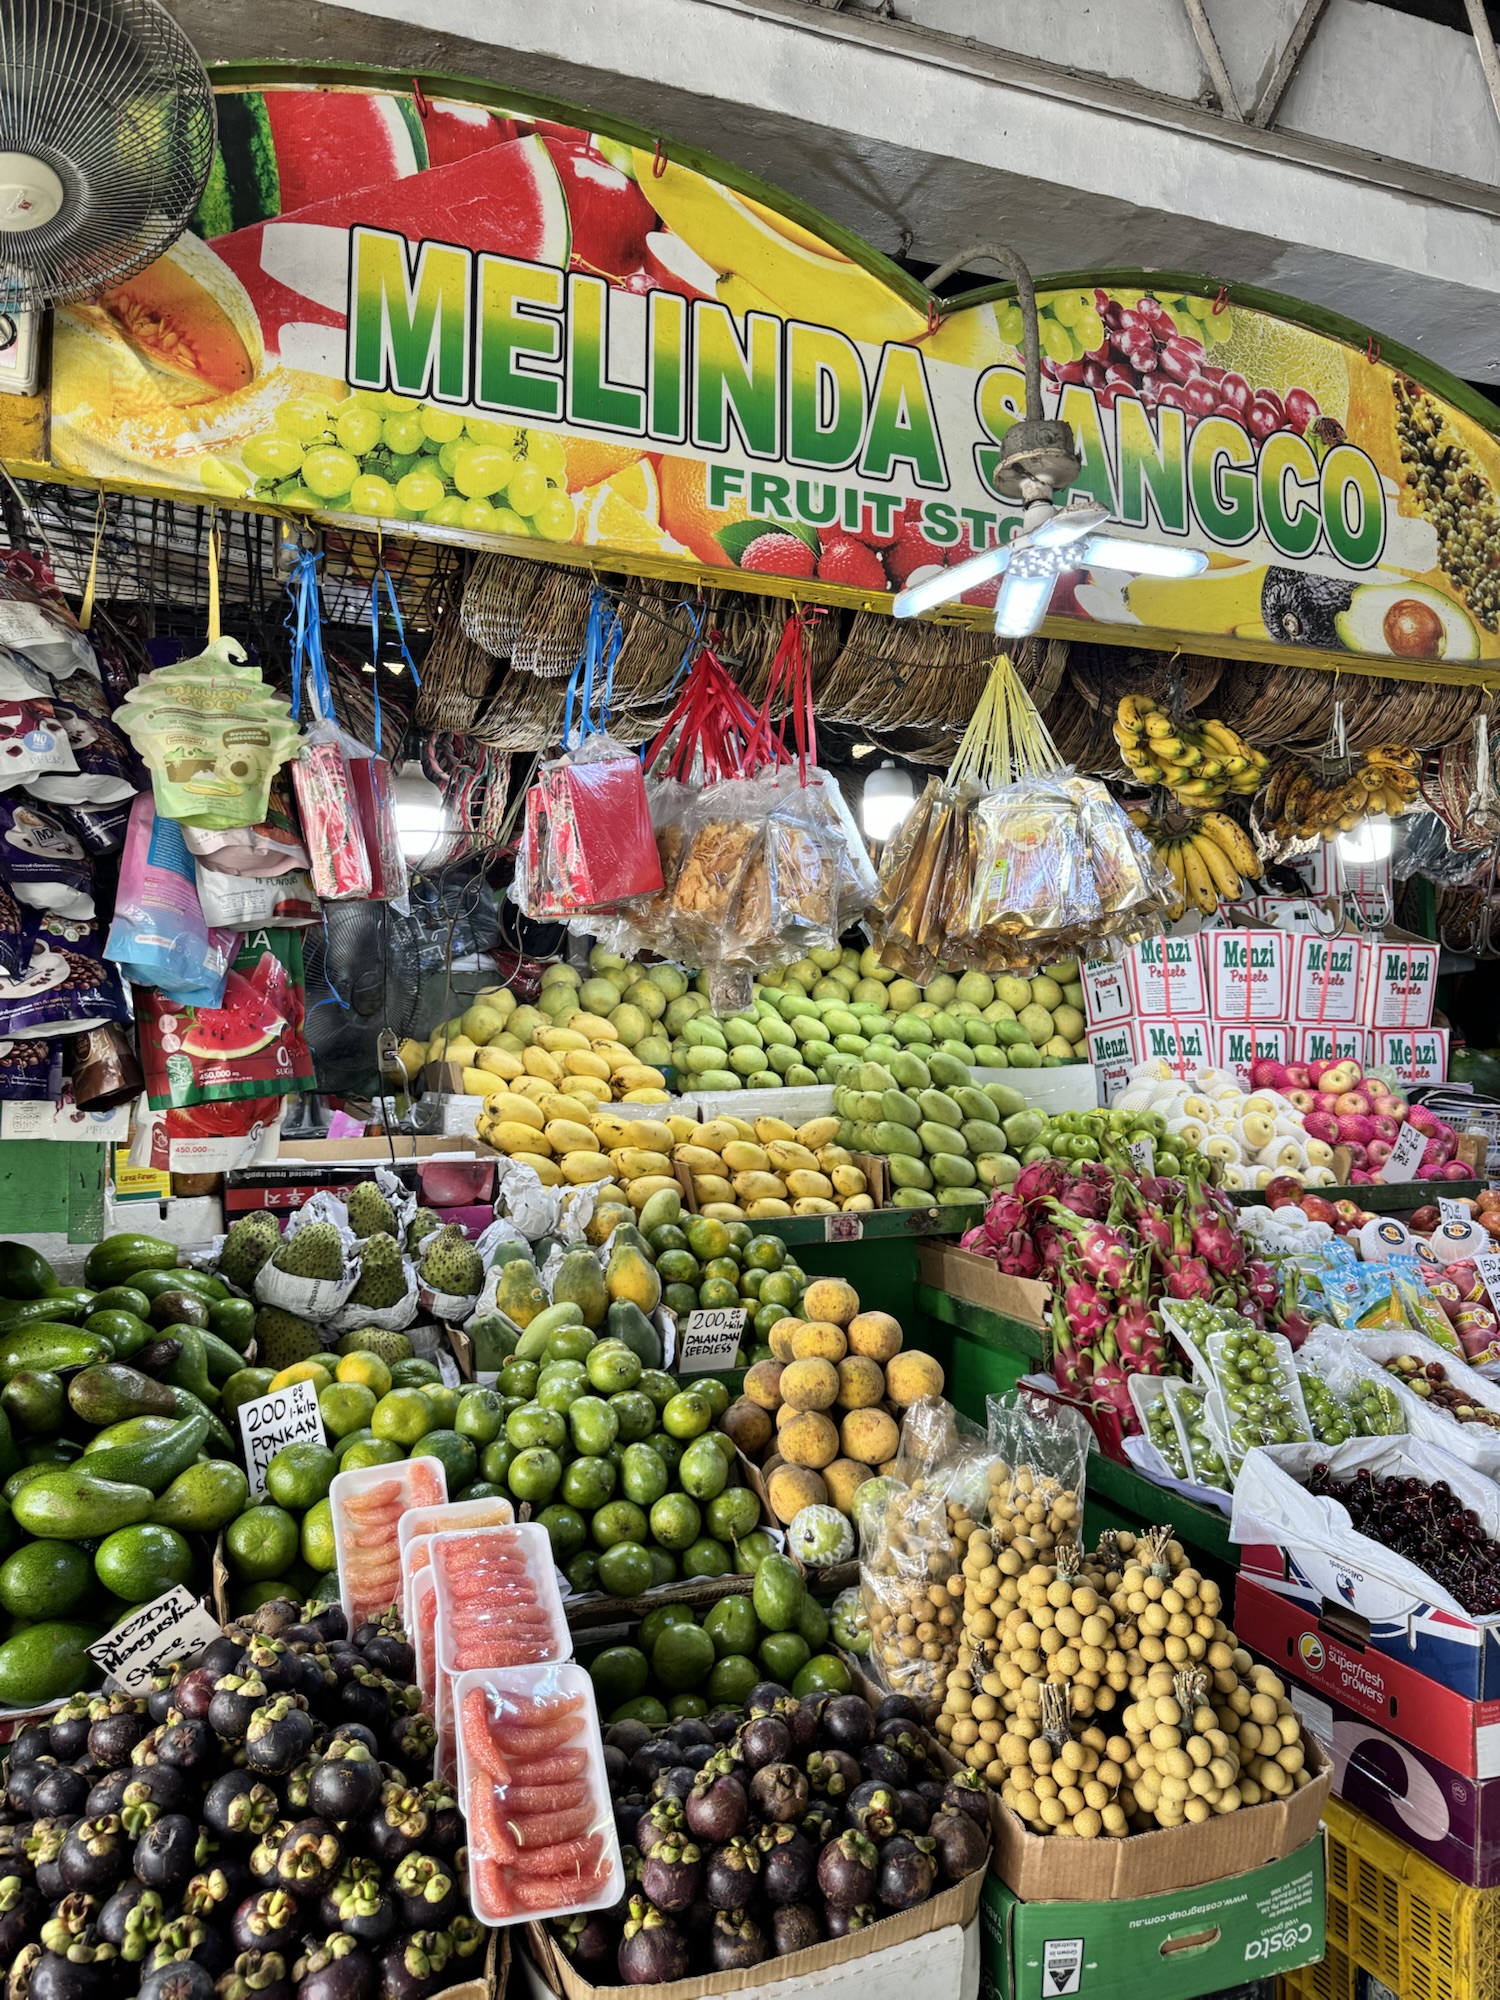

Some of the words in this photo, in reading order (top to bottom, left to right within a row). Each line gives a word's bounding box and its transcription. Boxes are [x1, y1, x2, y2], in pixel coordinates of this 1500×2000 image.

[346, 224, 951, 492] MELINDA
[974, 364, 1387, 571] SANGCO
[710, 464, 902, 534] FRUIT
[165, 685, 249, 704] MILLION
[176, 695, 236, 712] GLOW
[1141, 938, 1192, 964] Menzi
[1223, 940, 1275, 968] Menzi
[1307, 943, 1352, 972] Menzi
[1093, 974, 1118, 989] Pomelo
[1385, 955, 1429, 981] Menzi
[1094, 1030, 1129, 1061] Menzi
[1150, 1028, 1202, 1057] Menzi
[1229, 1034, 1280, 1062] Menzi
[1310, 1035, 1356, 1062] Menzi
[1389, 1037, 1437, 1066] Menzi
[199, 1069, 231, 1081] 450,000
[1103, 1066, 1127, 1080] Pomelo
[175, 1146, 208, 1154] 450,000
[692, 1311, 725, 1330] 200
[685, 1342, 732, 1358] SEEDLESS
[246, 1398, 286, 1432] 200
[252, 1415, 317, 1457] PONKAN
[86, 1597, 178, 1661] Quezon
[1328, 1651, 1385, 1691] superfresh
[1341, 1672, 1384, 1704] growers
[1129, 1893, 1248, 1928] www.costagroup.com.au
